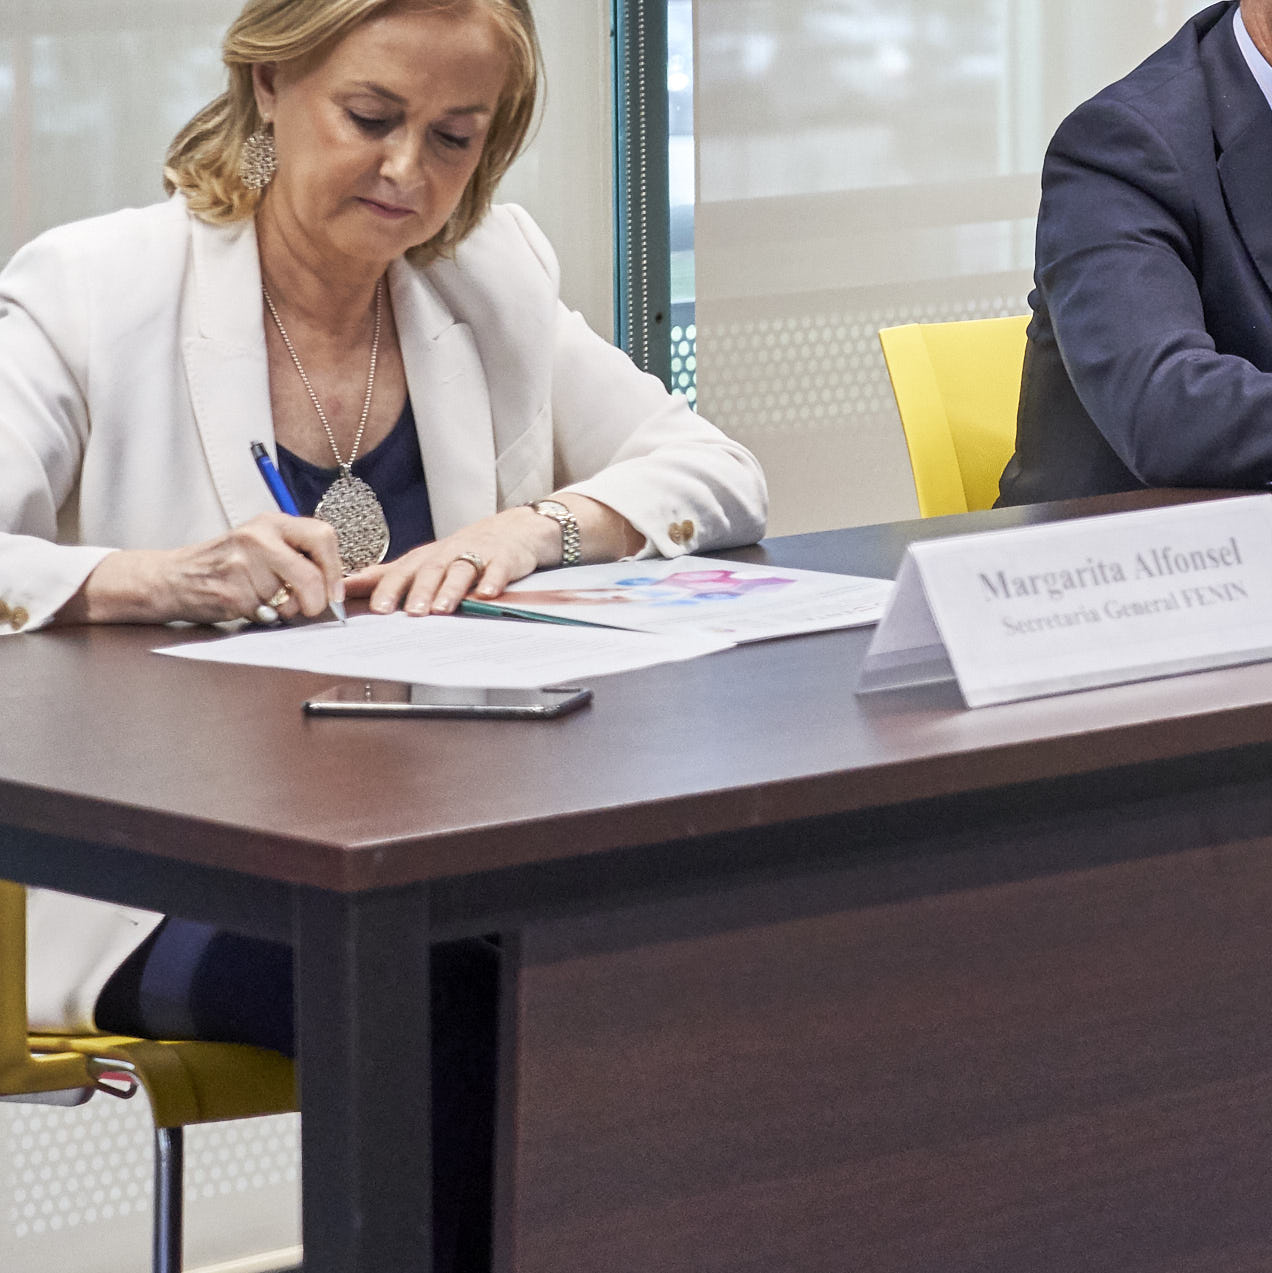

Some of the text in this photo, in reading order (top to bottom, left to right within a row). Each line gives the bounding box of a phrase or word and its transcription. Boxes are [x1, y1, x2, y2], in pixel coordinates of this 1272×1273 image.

[976, 536, 1243, 604] Margarita Alfonsel
[1105, 591, 1181, 620] General
[1181, 580, 1249, 612] FENIN
